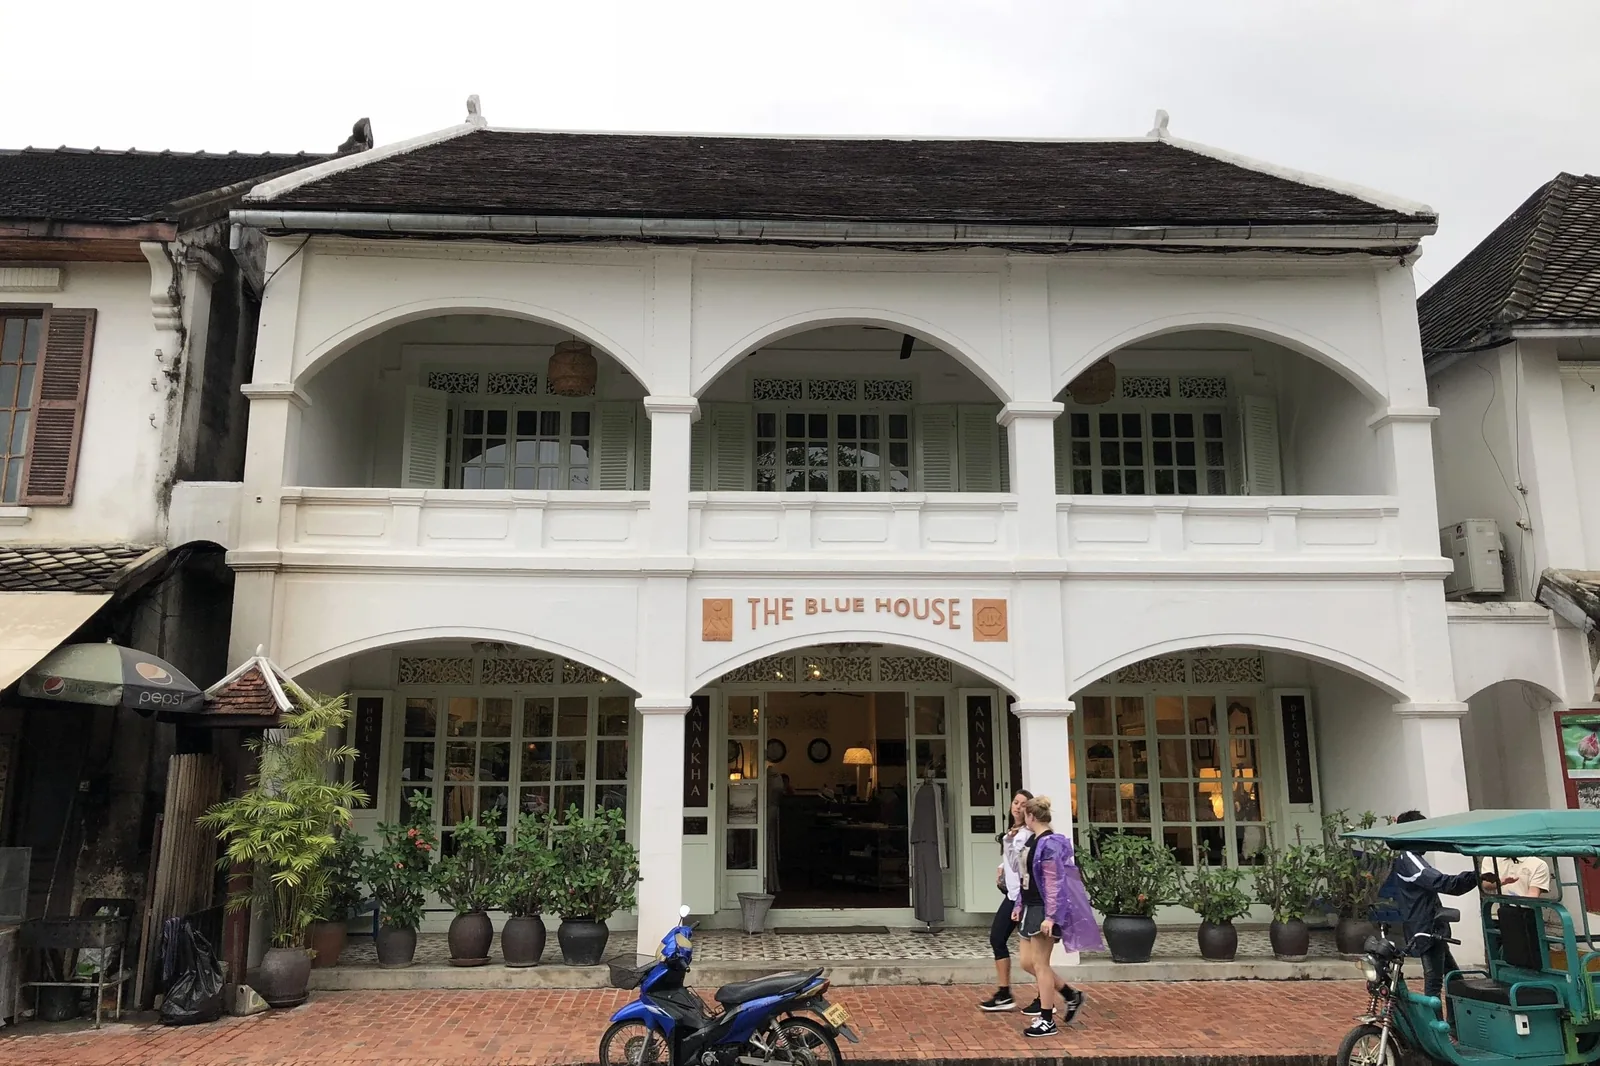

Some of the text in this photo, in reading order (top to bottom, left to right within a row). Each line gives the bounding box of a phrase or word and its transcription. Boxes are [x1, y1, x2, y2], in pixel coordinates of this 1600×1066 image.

[747, 597, 961, 630] THE BLUE HOUSE
[139, 691, 184, 708] pepsi
[690, 705, 702, 796] ANAKHA
[974, 705, 987, 796] ANAKHA
[1290, 704, 1304, 793] DECORATION
